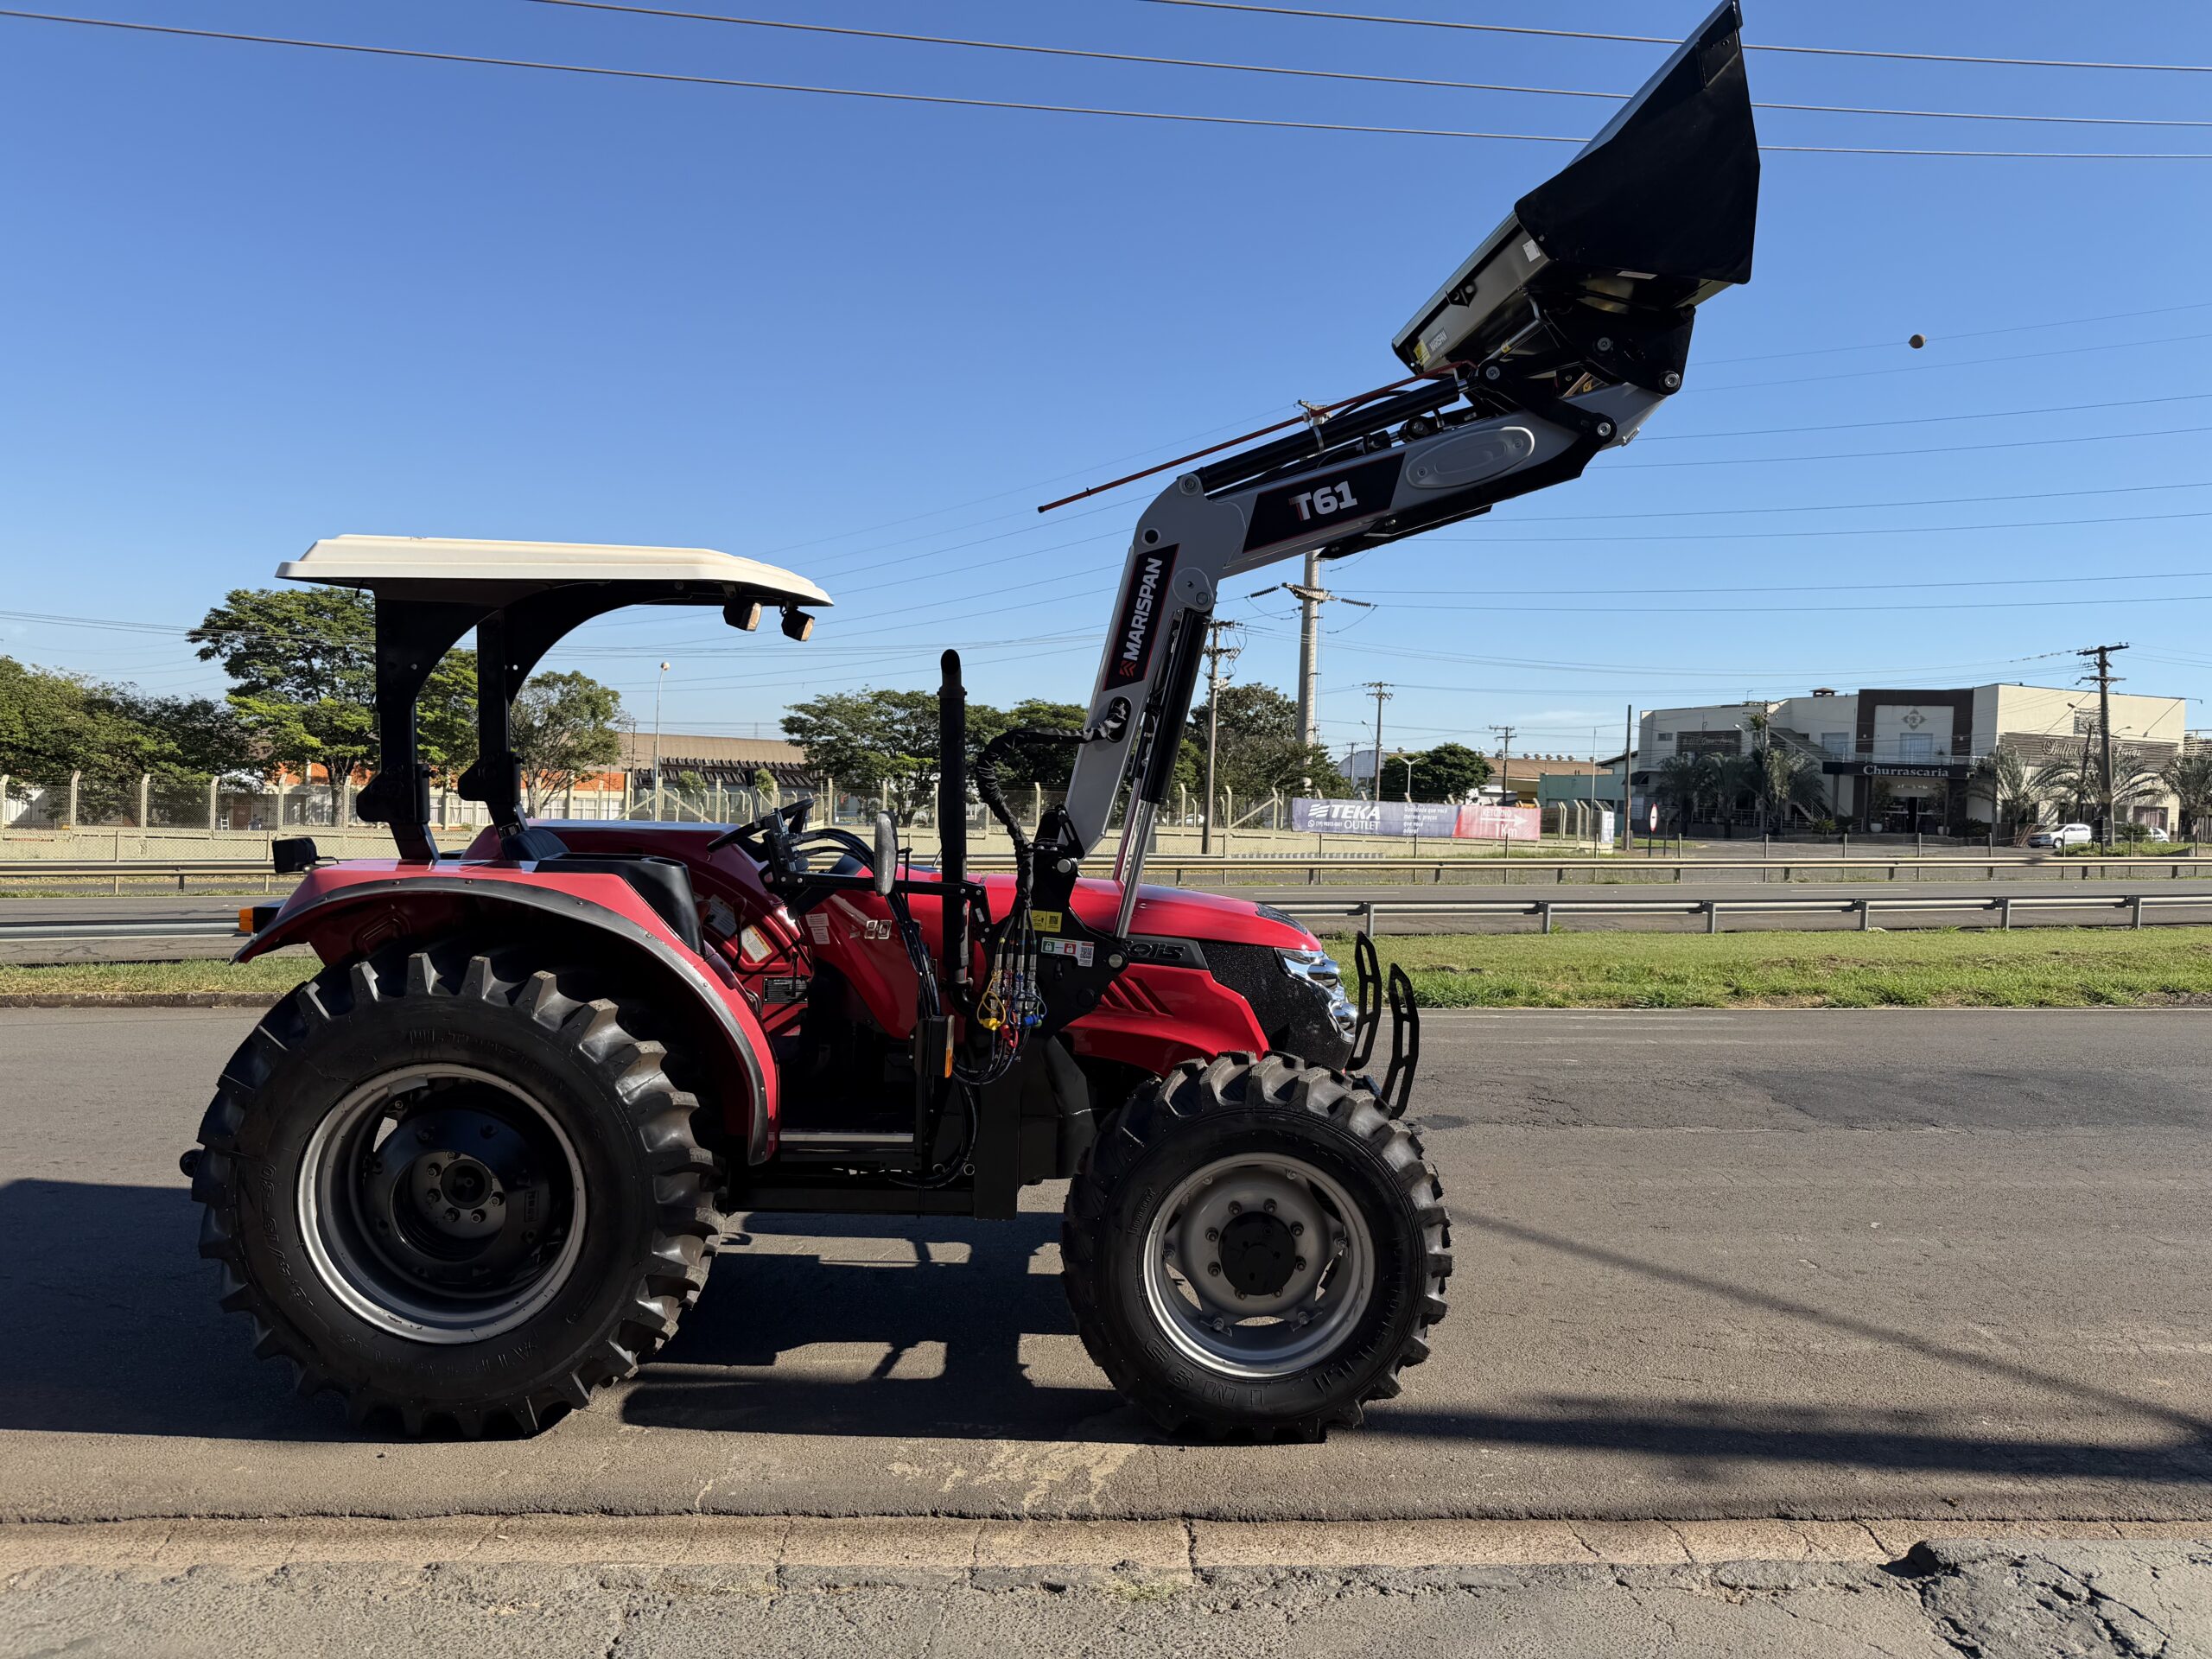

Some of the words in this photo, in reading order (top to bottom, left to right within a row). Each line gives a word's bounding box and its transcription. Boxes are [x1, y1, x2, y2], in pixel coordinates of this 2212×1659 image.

[1288, 480, 1358, 521] T61
[1122, 556, 1164, 661] MARISPAN
[2042, 739, 2079, 759] Buffet
[1863, 765, 1949, 777] Churrascaria
[1332, 804, 1380, 820] TEKA
[1482, 809, 1512, 817] RETORNO
[1344, 820, 1380, 830] OUTLET
